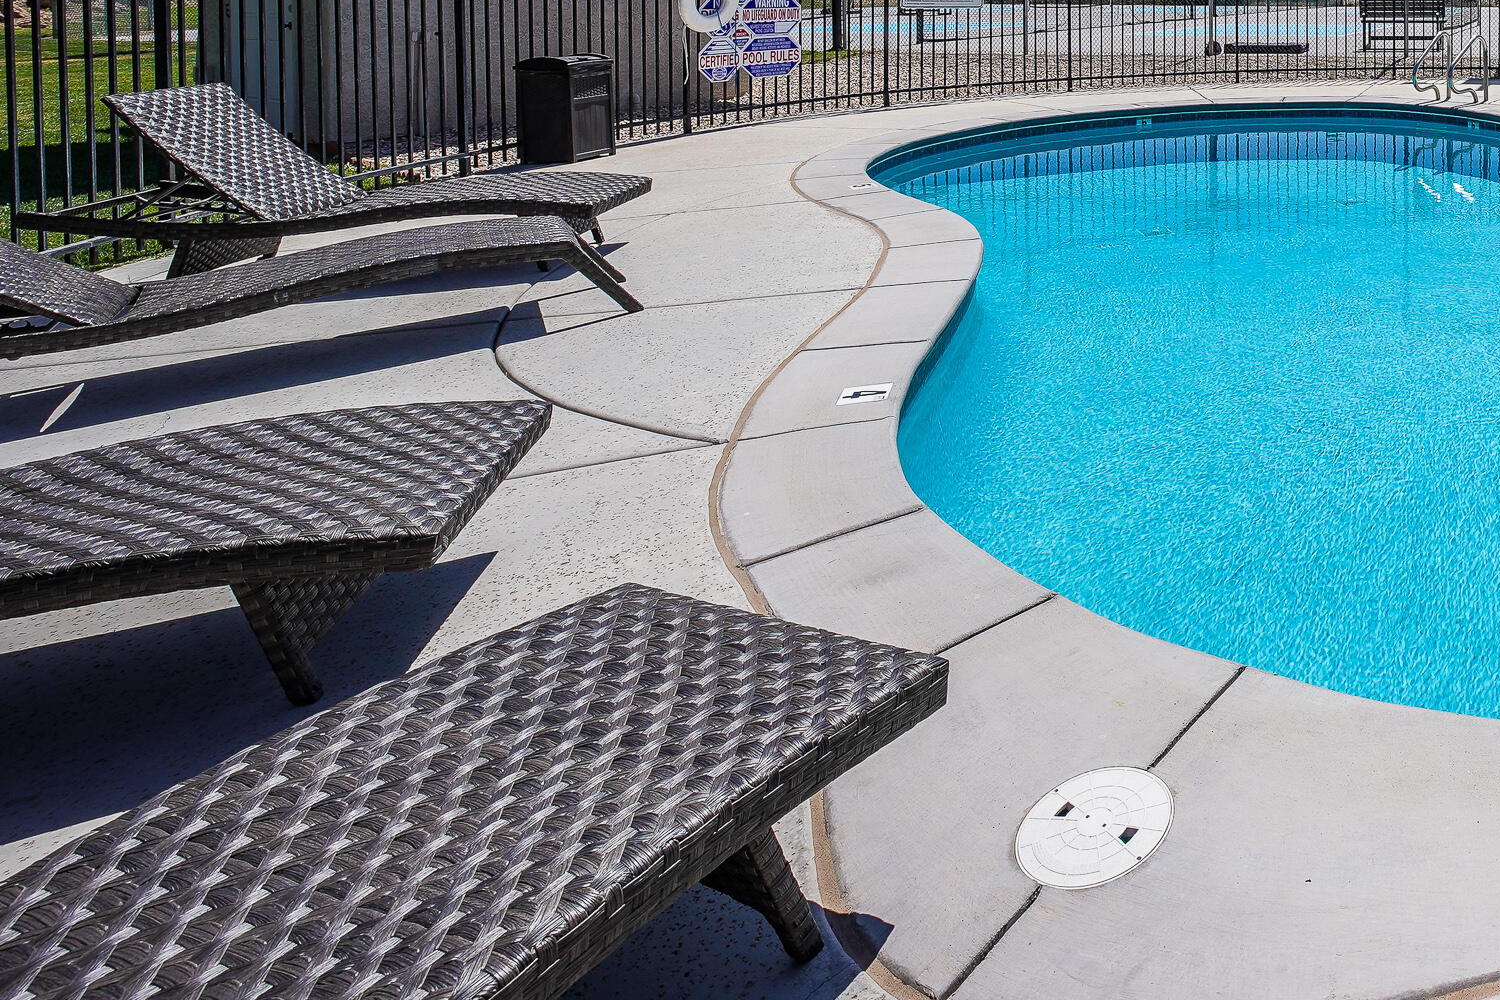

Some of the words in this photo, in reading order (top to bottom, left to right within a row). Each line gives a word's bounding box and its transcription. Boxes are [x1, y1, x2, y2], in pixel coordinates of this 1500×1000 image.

[742, 10, 751, 21] NO
[751, 9, 778, 21] LIFEGUARD
[778, 9, 787, 19] ON
[787, 8, 800, 19] DUTY
[700, 54, 740, 68] CERTIFIED
[742, 51, 768, 64] POOL
[769, 49, 800, 62] RULES
